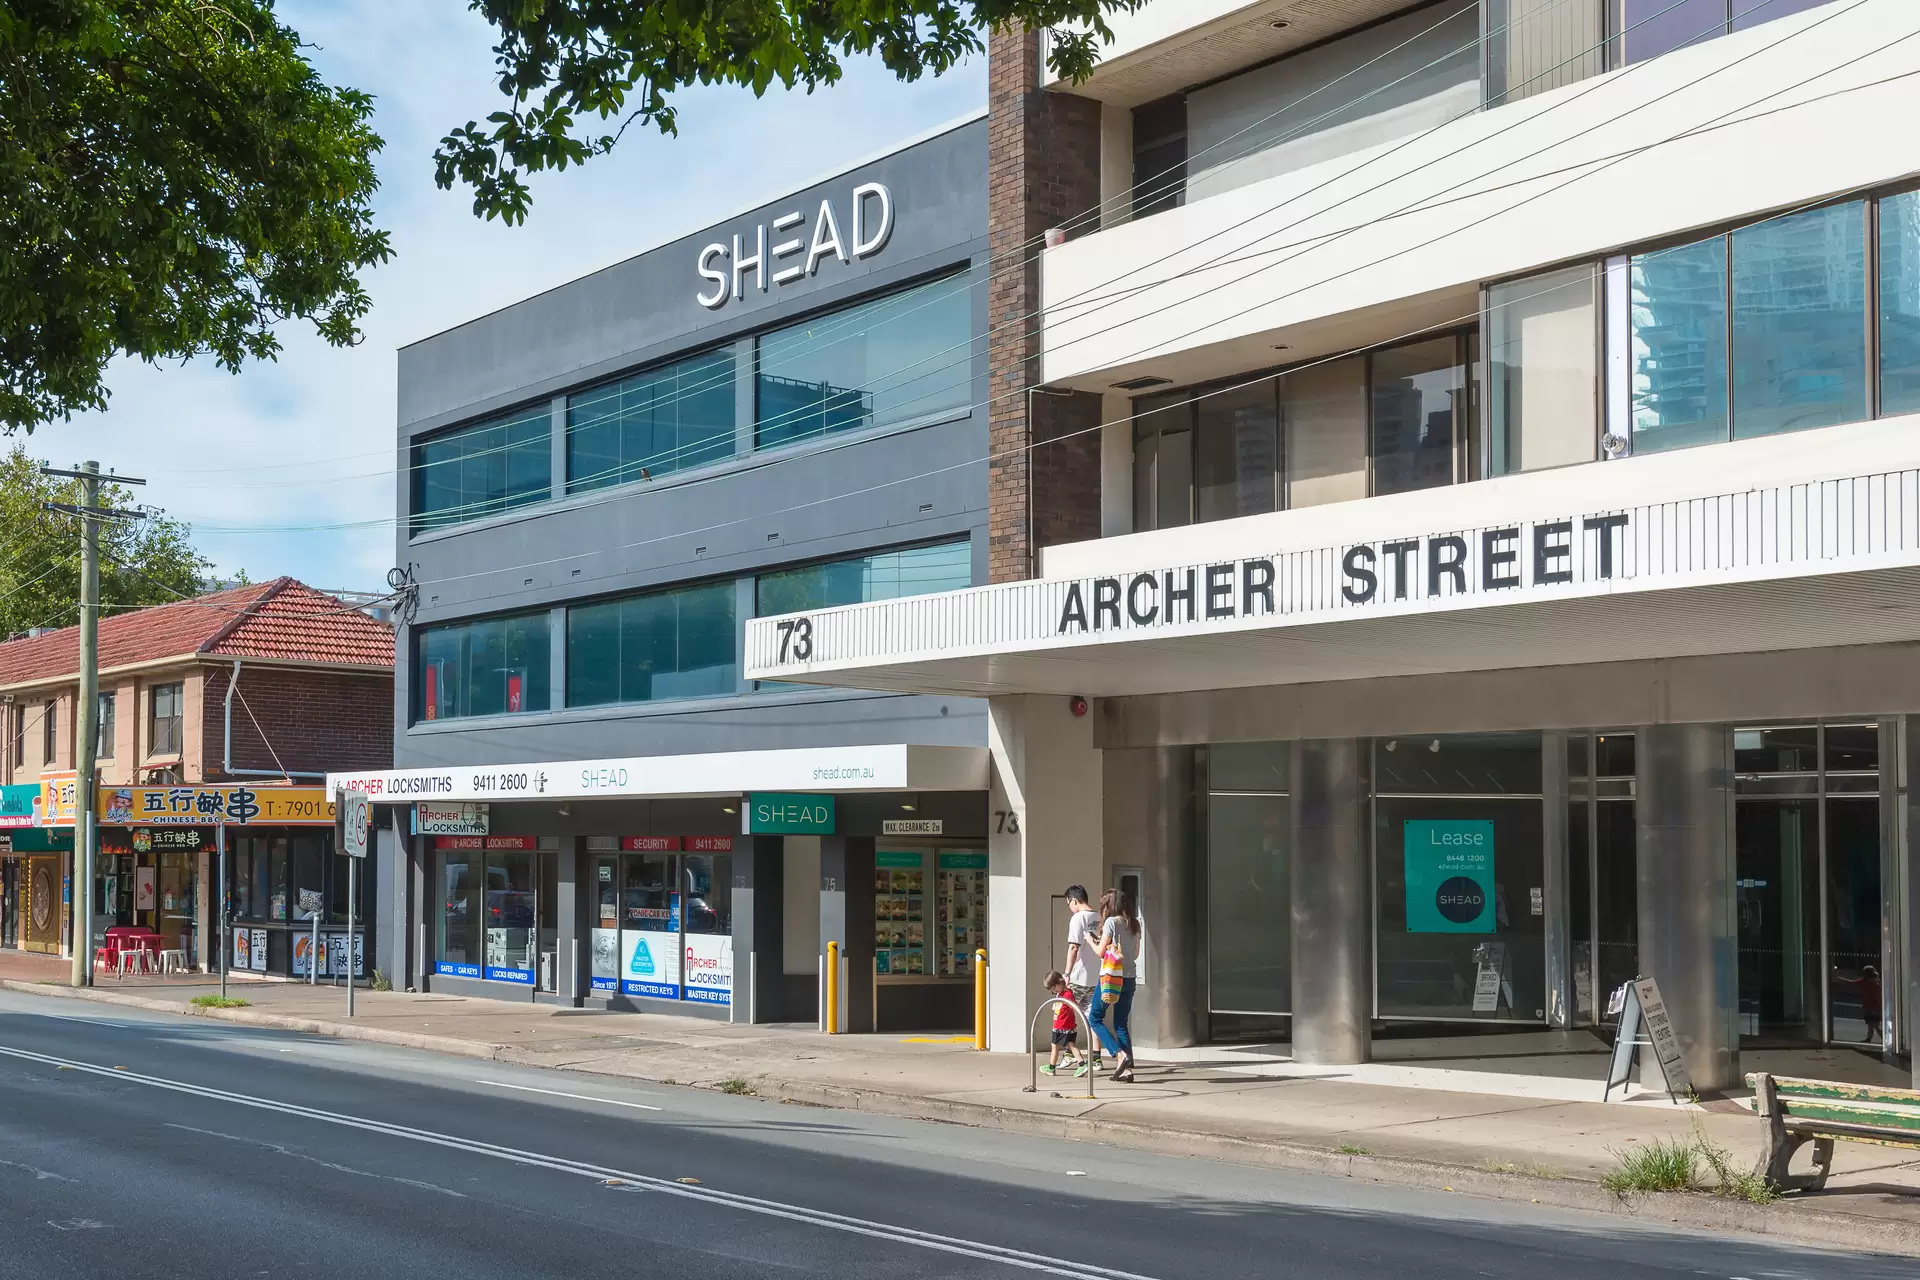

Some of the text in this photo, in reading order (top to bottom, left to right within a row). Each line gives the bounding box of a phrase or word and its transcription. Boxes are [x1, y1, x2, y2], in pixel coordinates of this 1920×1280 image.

[696, 181, 894, 308] SHEAD
[777, 512, 1628, 662] 73 ARCHER STREET
[581, 768, 628, 788] SHEAD
[813, 765, 874, 780] shead.com.au
[345, 775, 452, 794] ARCHER LOCKSMITHS
[473, 773, 528, 791] 9411 2600
[420, 803, 459, 822] ARCHER
[758, 804, 828, 824] SHEAD
[357, 815, 366, 835] 40
[423, 814, 487, 833] LOCKSMITHS
[899, 822, 929, 832] CLEARANCE
[932, 822, 941, 832] 2m
[994, 810, 1019, 834] 73
[458, 838, 523, 848] ARCHER LOCKSMITHS
[633, 838, 669, 849] SECURITY
[695, 839, 731, 850] 9411 2600
[1431, 828, 1484, 846] Lease
[1467, 854, 1485, 862] 1200
[824, 877, 836, 892] 75
[1440, 895, 1481, 905] SHEAD
[649, 909, 660, 918] CAR
[686, 946, 717, 970] ARCHER
[440, 964, 453, 973] SAFES
[492, 970, 528, 980] LOCKS REPAIRED
[592, 980, 606, 989] Since
[628, 983, 673, 996] RESTRICTED KEYS
[687, 989, 708, 1000] MASTER
[708, 991, 719, 1000] KEY
